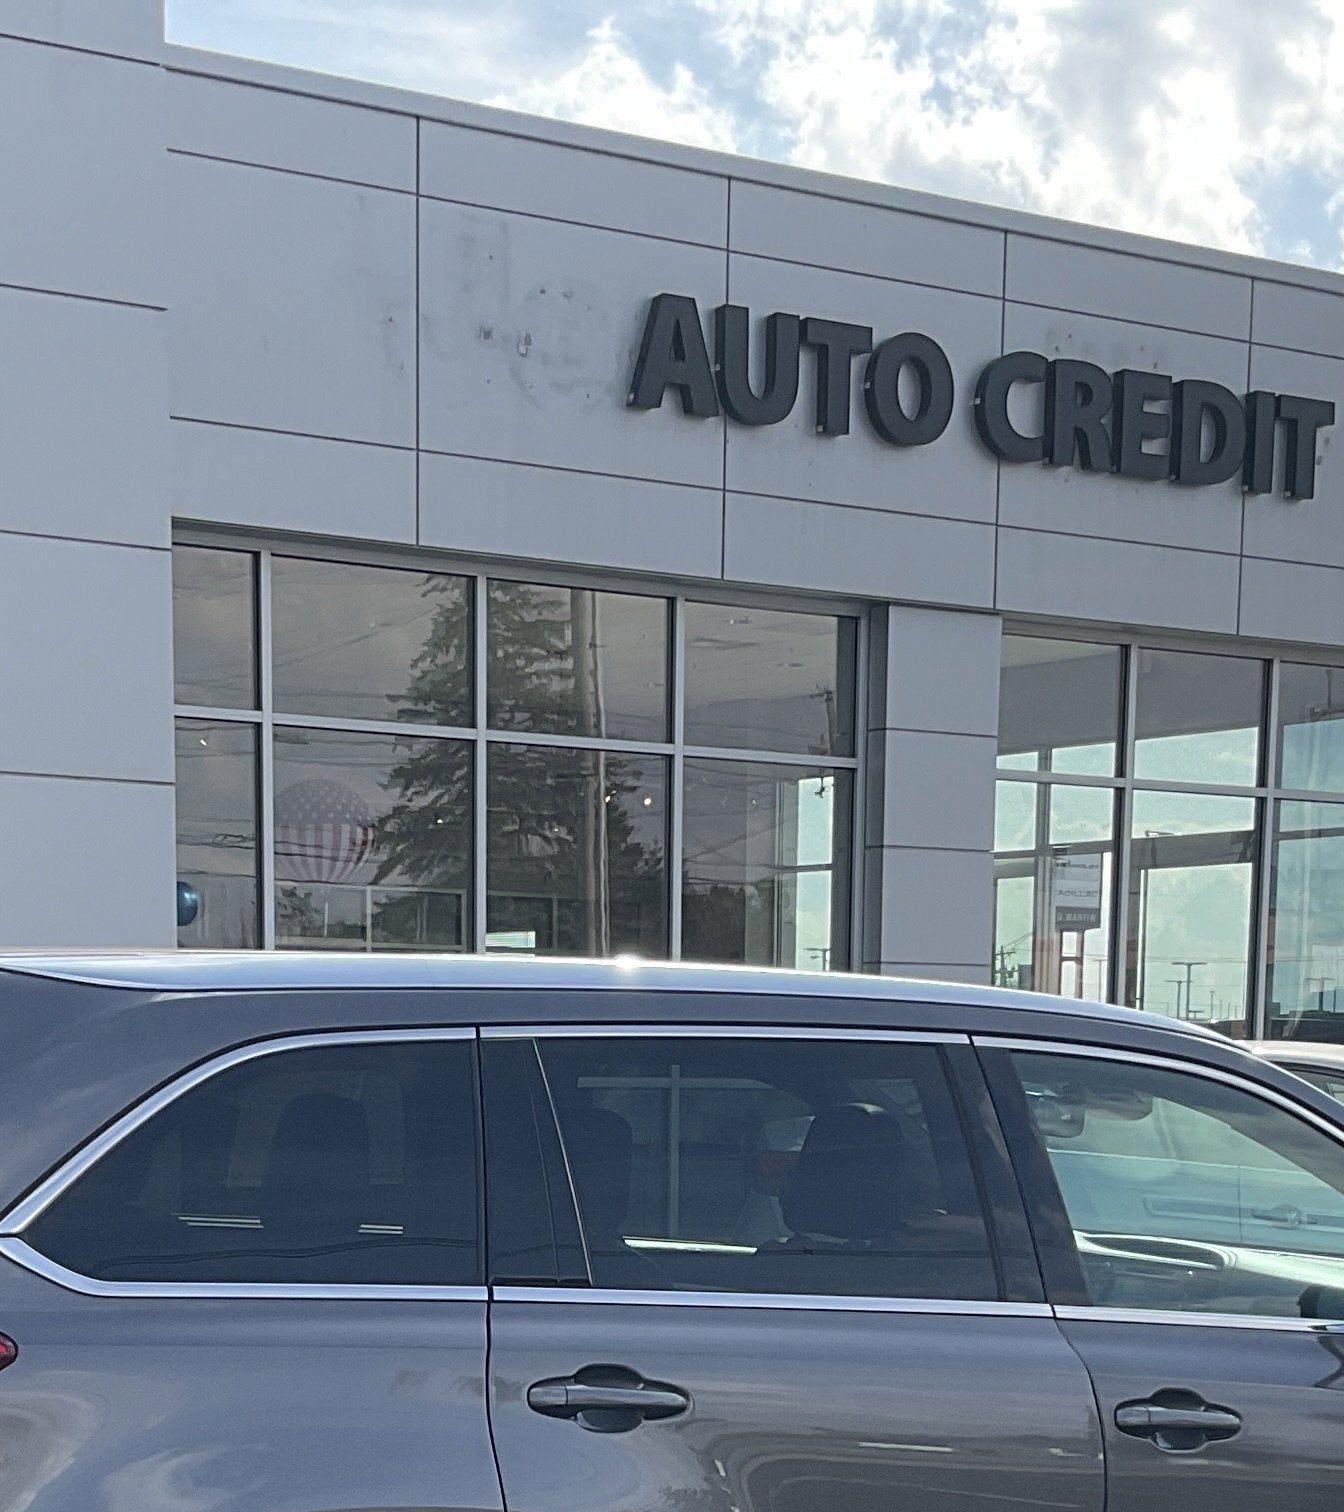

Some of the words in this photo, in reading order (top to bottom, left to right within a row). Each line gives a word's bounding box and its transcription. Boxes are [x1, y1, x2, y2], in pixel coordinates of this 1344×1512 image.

[626, 293, 954, 448] AUTO
[974, 350, 1336, 501] CREDIT
[1056, 889, 1098, 897] ADILLAC
